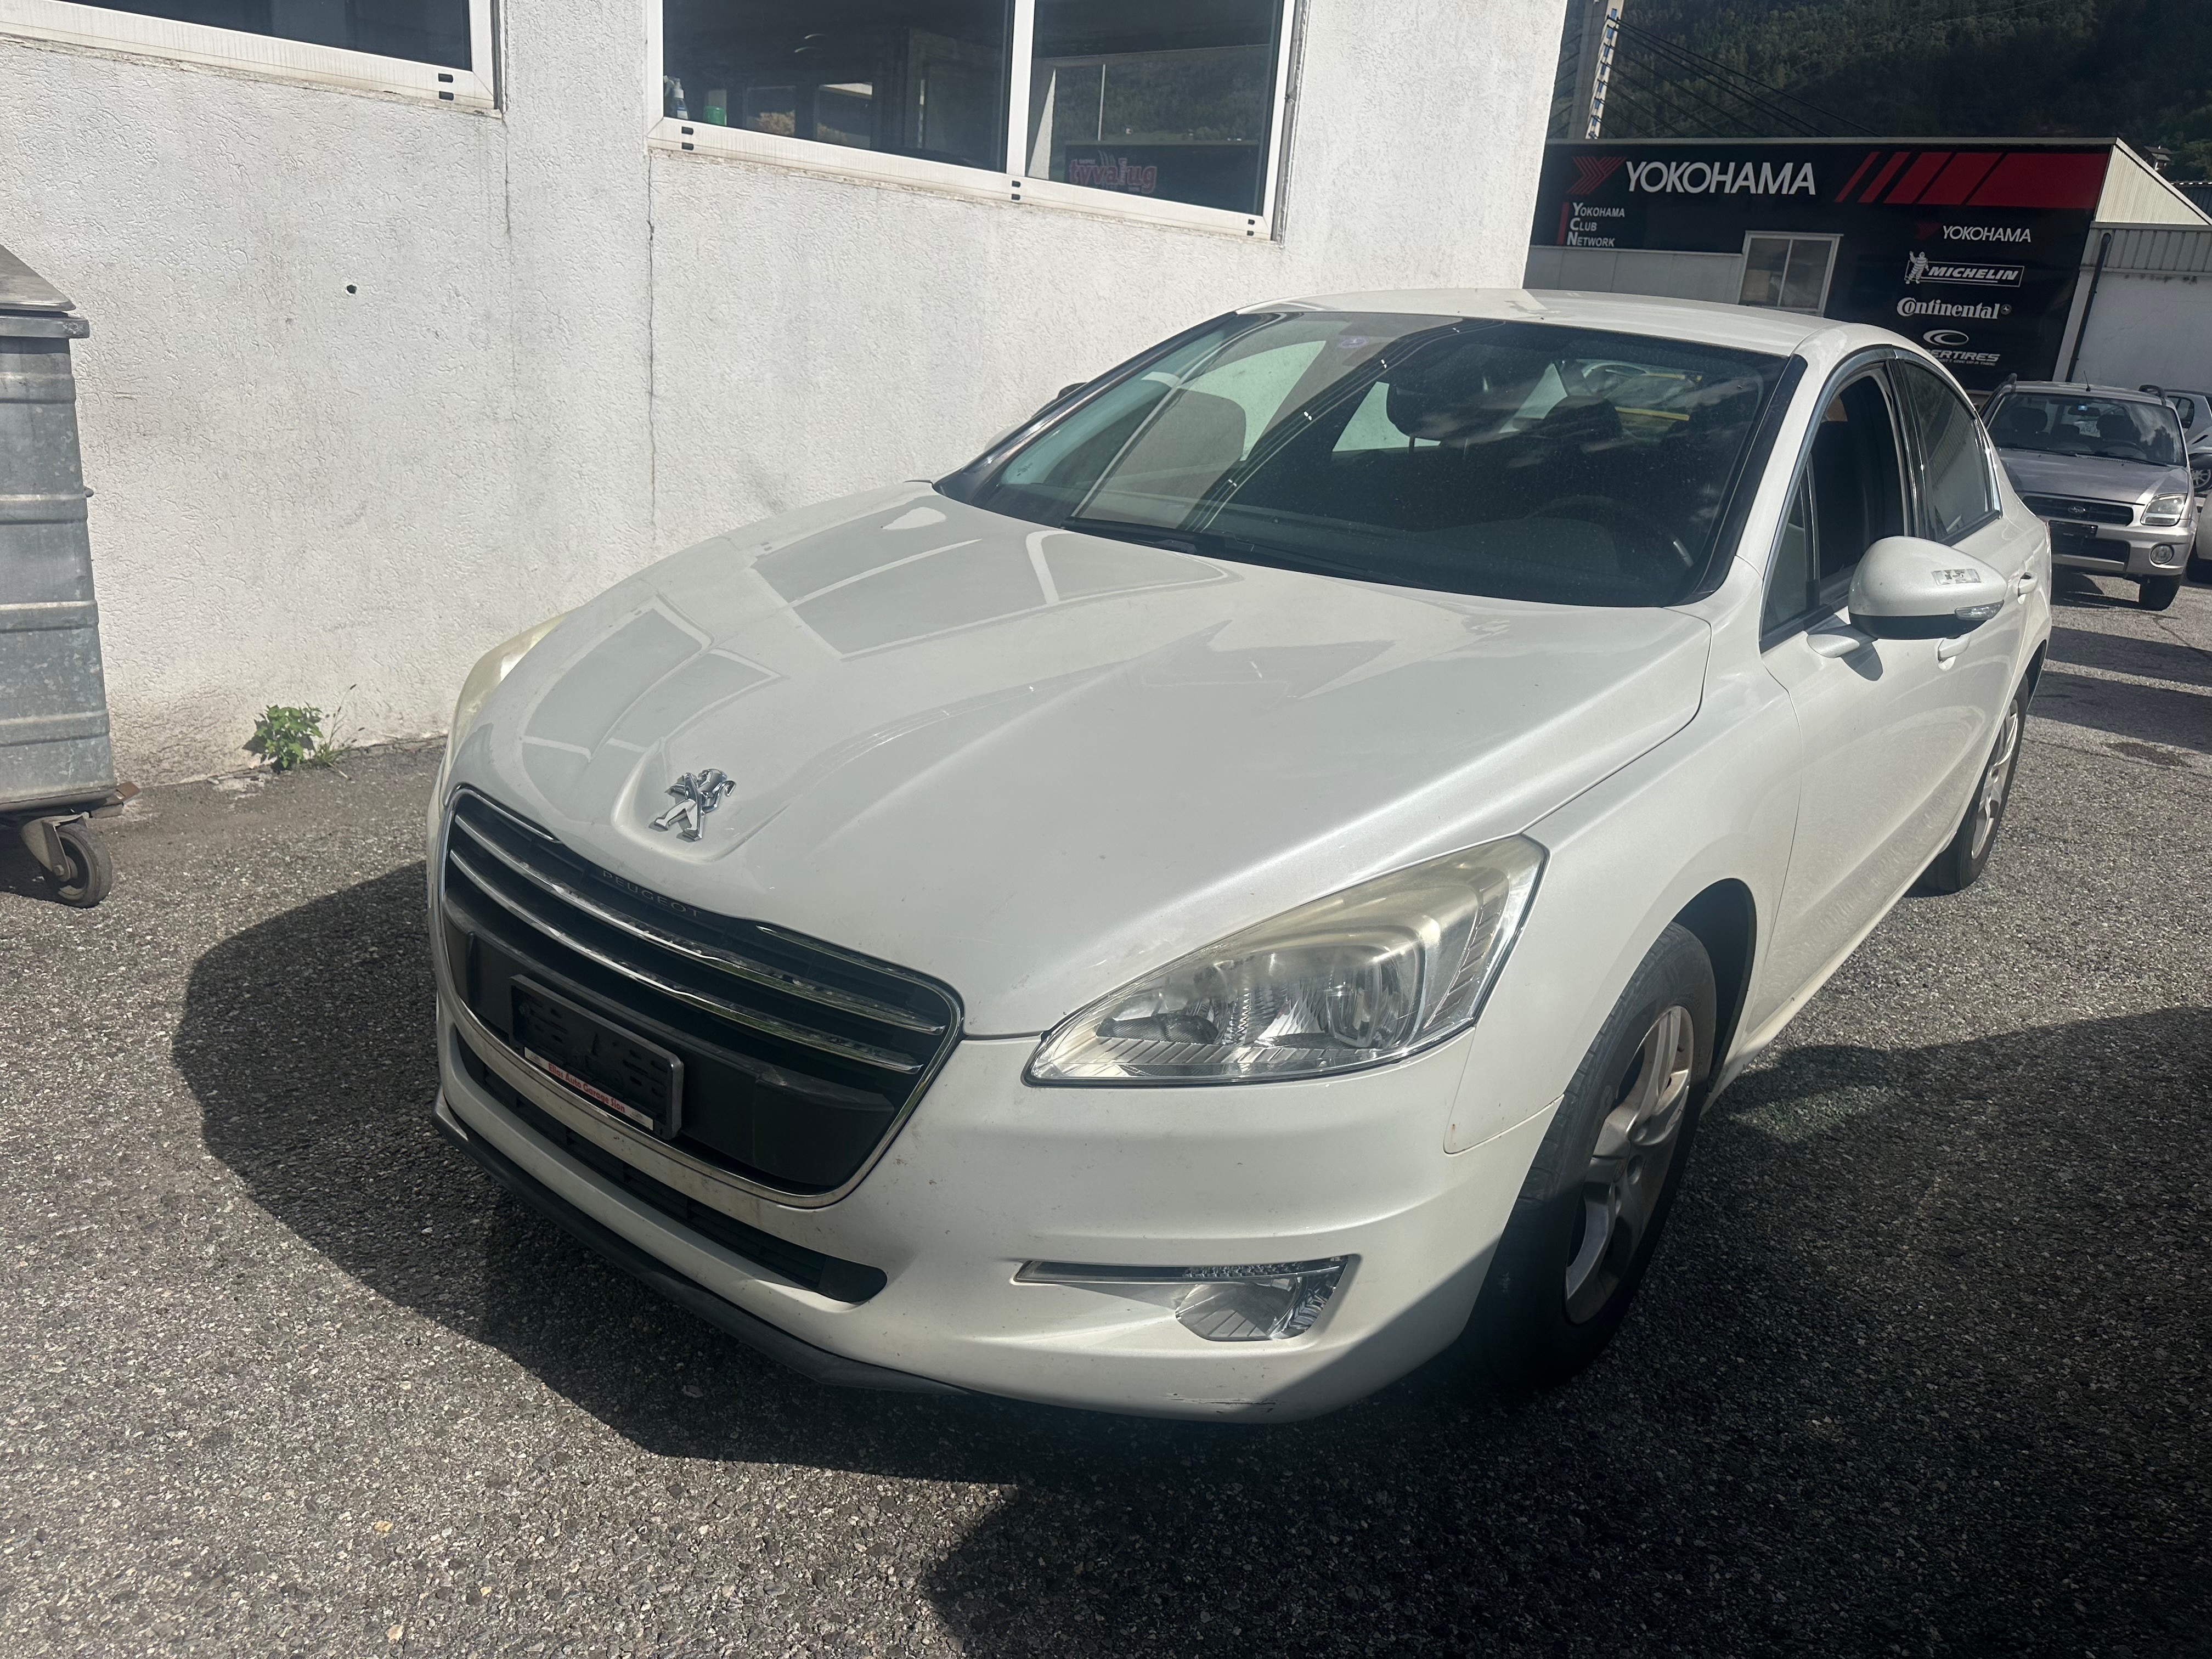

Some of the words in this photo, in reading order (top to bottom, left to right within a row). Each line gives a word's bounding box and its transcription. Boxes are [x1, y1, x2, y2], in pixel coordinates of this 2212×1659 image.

[1626, 161, 1816, 195] YOKOHAMA
[1572, 202, 1626, 218] YOKOHAMA
[1570, 217, 1598, 231] CLUB
[1567, 231, 1616, 247] NETWORK
[1943, 225, 2032, 242] YOKOHAMA
[1927, 266, 2019, 280] MICHELIN
[1897, 297, 2000, 319] Continental
[603, 870, 702, 917] PEUGEOT
[565, 1073, 582, 1088] Auto
[583, 1081, 609, 1104] Garage
